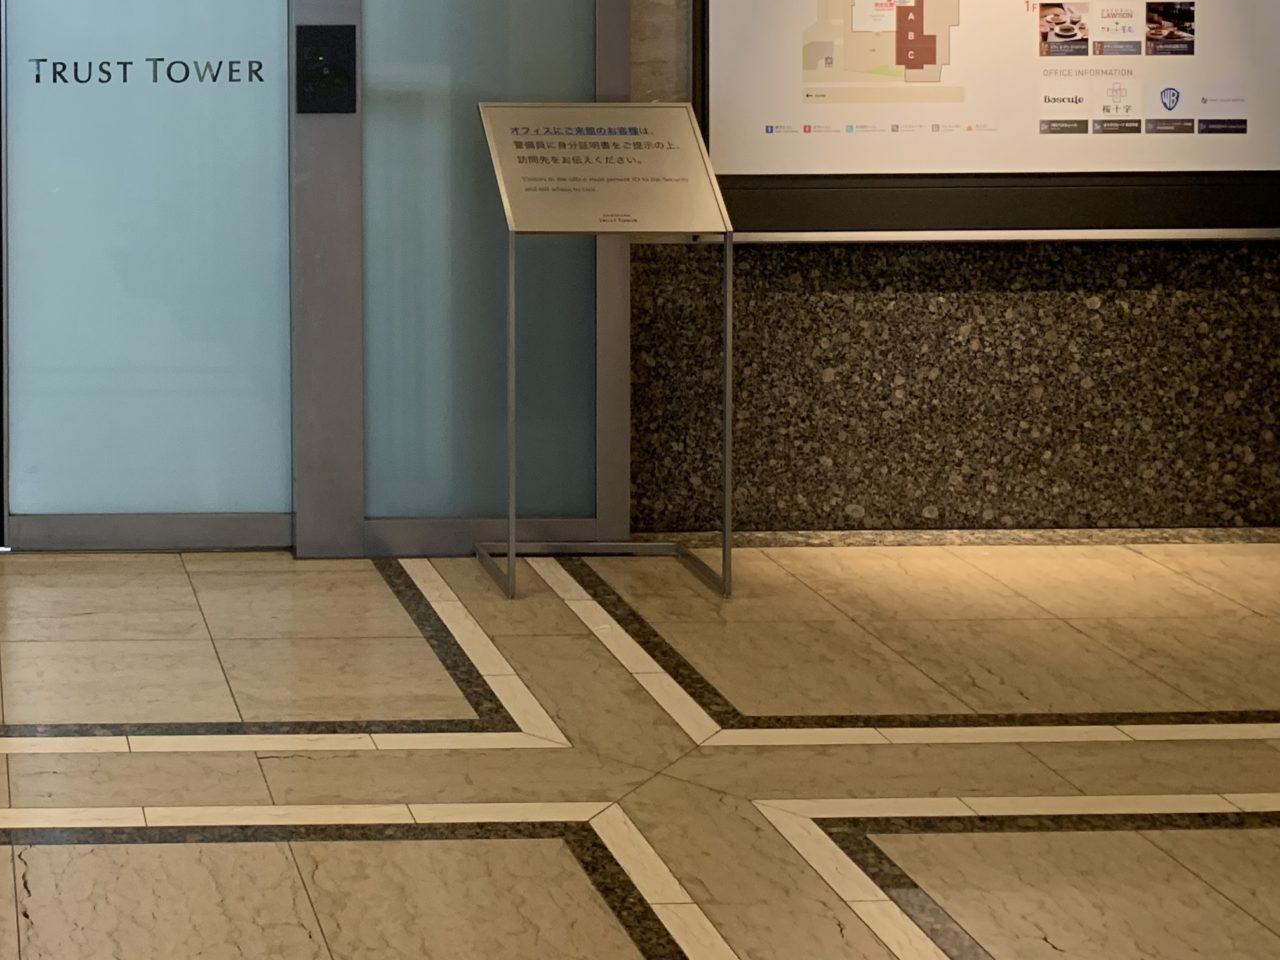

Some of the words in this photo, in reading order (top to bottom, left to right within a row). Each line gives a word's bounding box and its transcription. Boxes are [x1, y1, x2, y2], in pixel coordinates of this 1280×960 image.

[1024, 0, 1038, 13] 1F
[907, 12, 915, 21] A
[907, 31, 915, 40] B
[907, 50, 915, 59] C
[28, 58, 134, 84] TRUST
[145, 57, 265, 83] TOWER
[1042, 68, 1073, 77] OFFICE
[1074, 68, 1133, 77] INFORMATION
